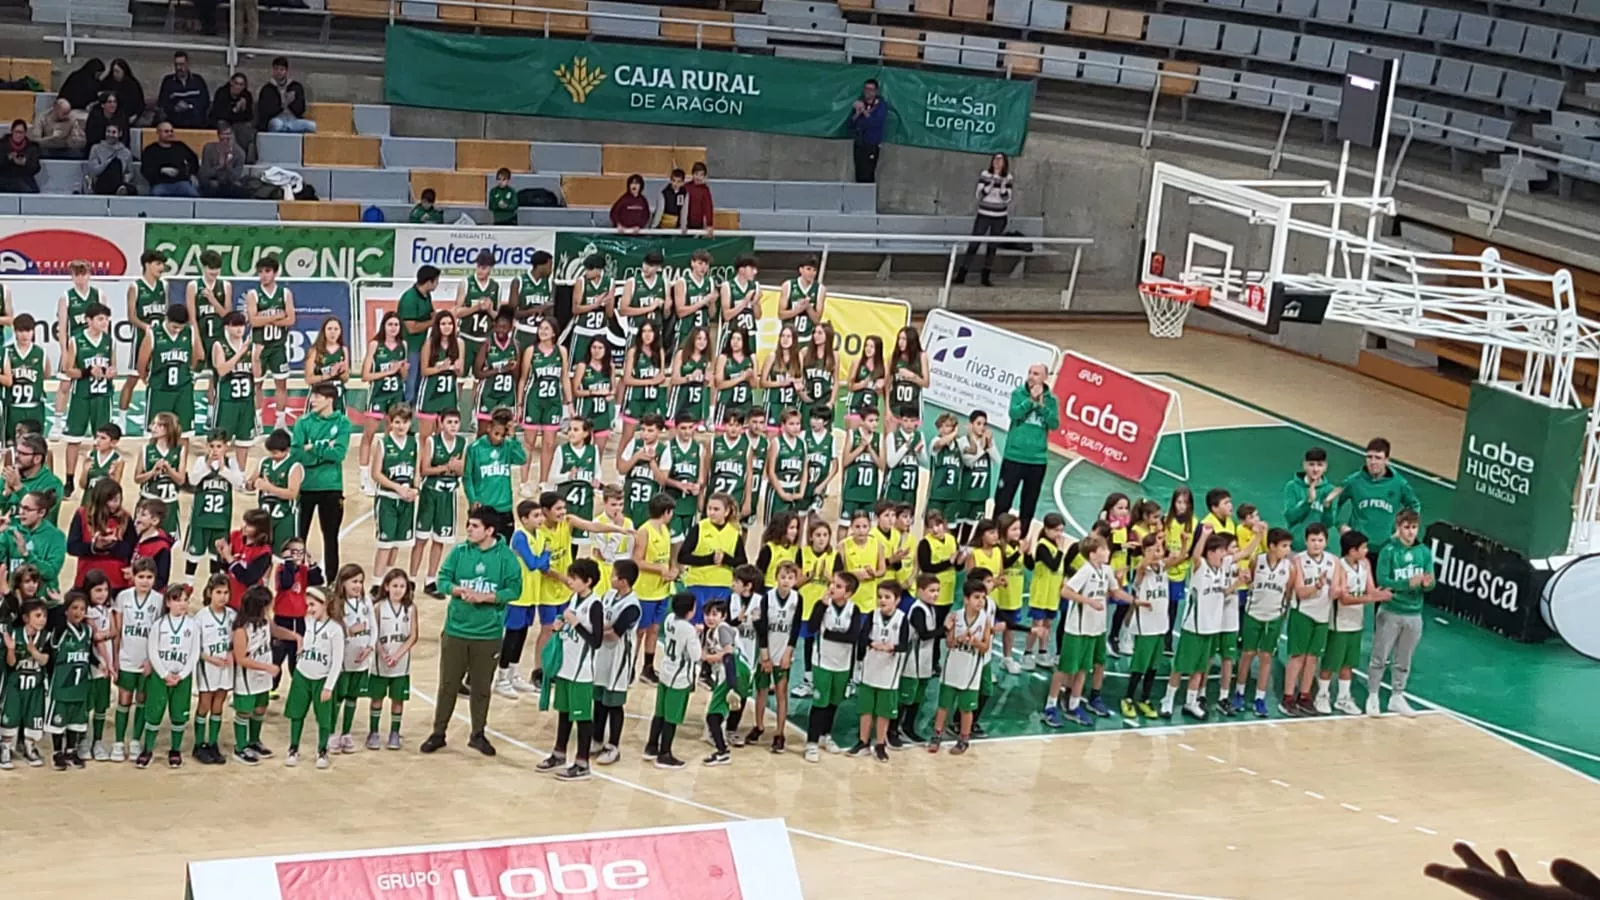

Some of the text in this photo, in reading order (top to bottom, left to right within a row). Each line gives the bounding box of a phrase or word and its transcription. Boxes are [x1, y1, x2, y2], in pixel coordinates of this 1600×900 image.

[614, 65, 761, 96] CAJA RURAL
[630, 93, 744, 116] DE ARAGÓN
[961, 96, 997, 117] San
[925, 111, 996, 134] Lorenzo
[207, 319, 214, 337] 1
[473, 315, 488, 333] 14
[587, 313, 604, 328] 28
[695, 312, 703, 326] 3
[738, 314, 753, 330] 20
[169, 367, 179, 385] 8
[966, 356, 996, 380] rivas
[231, 379, 251, 398] 33
[382, 377, 399, 392] 33
[437, 375, 452, 392] 31
[494, 374, 512, 392] 28
[539, 380, 556, 397] 26
[813, 380, 822, 398] 8
[12, 385, 34, 404] 99
[644, 386, 657, 399] 16
[689, 386, 701, 403] 15
[733, 386, 747, 403] 13
[780, 387, 794, 403] 12
[896, 383, 913, 402] 00
[593, 397, 605, 413] 18
[1066, 394, 1138, 443] Lobe
[1468, 434, 1535, 474] Lobe
[858, 467, 872, 486] 10
[901, 471, 916, 490] 31
[947, 469, 955, 485] 3
[971, 472, 988, 488] 77
[1466, 456, 1531, 496] Huesca
[630, 484, 651, 502] 33
[715, 479, 738, 494] 27
[204, 494, 224, 512] 32
[566, 487, 586, 506] 41
[1431, 537, 1519, 613] Huesca
[20, 675, 35, 690] 10
[74, 668, 81, 685] 1
[33, 717, 43, 728] 10
[377, 869, 441, 891] GRUPO
[452, 851, 649, 900] Lobe
